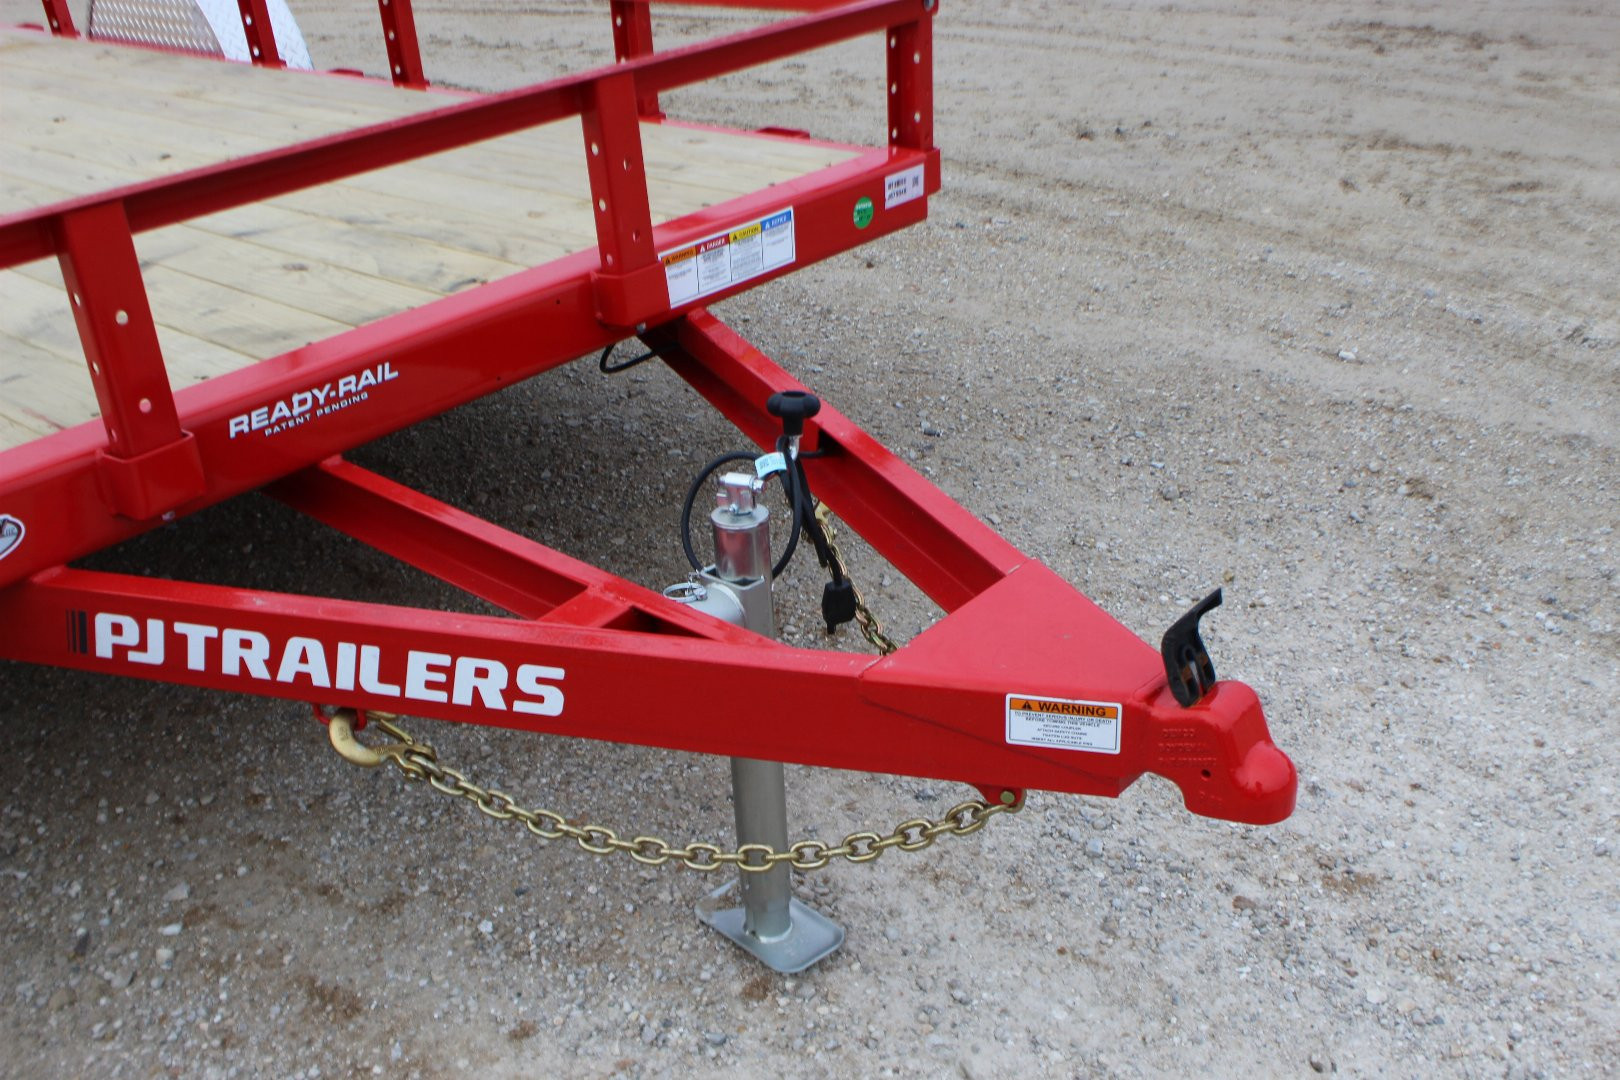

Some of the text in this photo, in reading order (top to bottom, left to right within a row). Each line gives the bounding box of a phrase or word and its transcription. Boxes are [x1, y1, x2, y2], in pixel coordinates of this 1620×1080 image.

[229, 362, 398, 439] READY-RAIL
[264, 391, 369, 437] PATENT PENDING
[94, 612, 566, 717] PJ TRAILERS
[1038, 702, 1107, 717] WARNING
